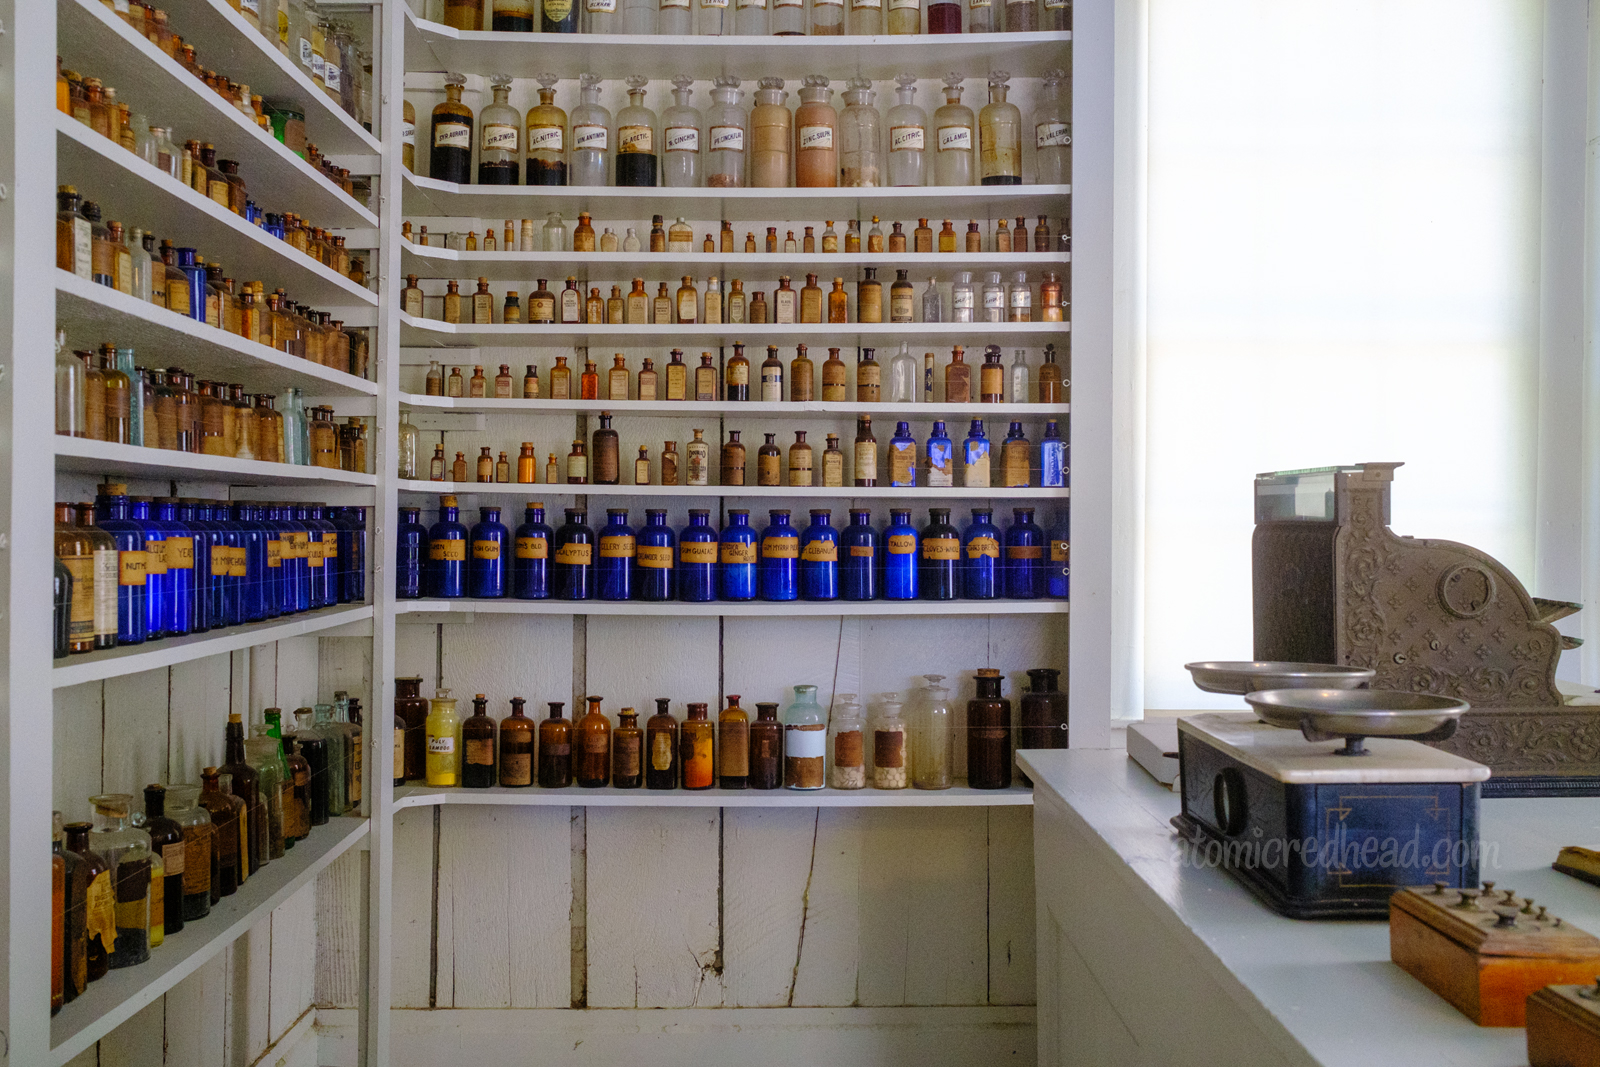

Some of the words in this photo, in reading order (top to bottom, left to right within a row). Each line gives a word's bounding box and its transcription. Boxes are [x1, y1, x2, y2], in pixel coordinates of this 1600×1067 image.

[942, 131, 969, 145] CALAMUS
[889, 540, 914, 548] TALLOW
[484, 545, 499, 553] GUM
[728, 549, 749, 557] GINGER
